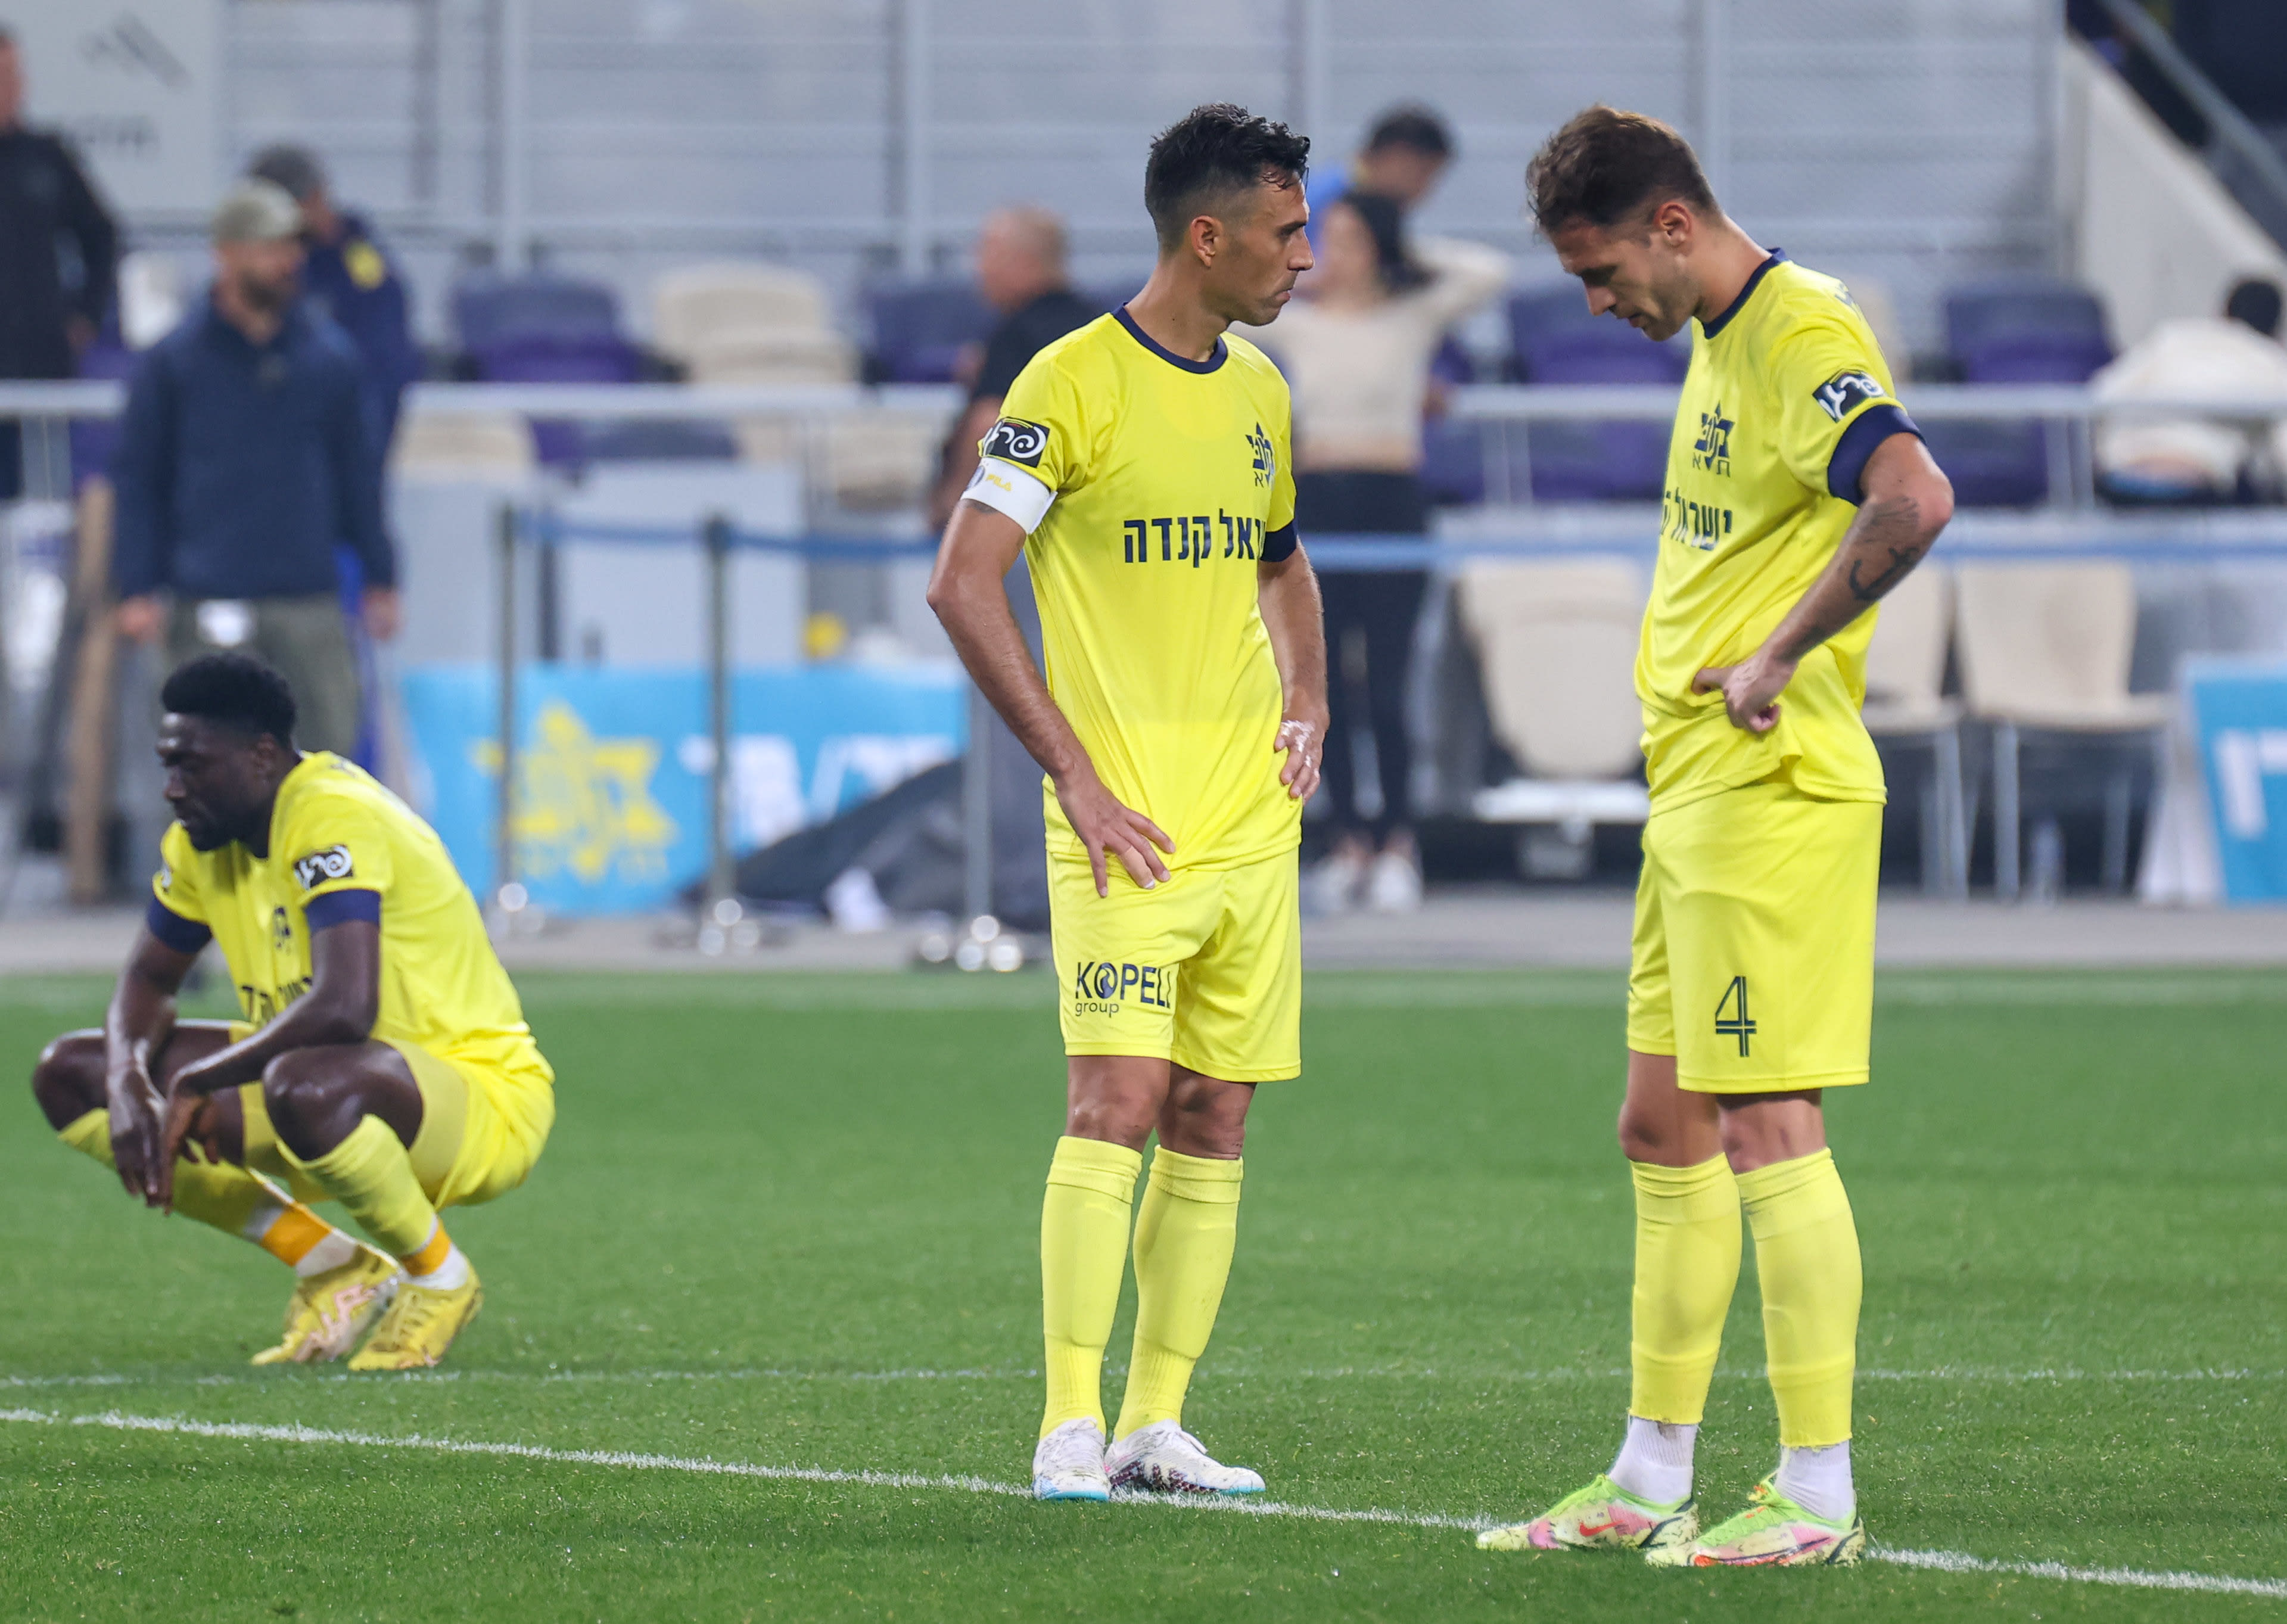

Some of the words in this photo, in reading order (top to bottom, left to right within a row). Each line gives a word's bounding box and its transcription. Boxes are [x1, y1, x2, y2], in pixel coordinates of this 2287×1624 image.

[1124, 516, 1212, 568] קנדה
[1075, 1001, 1120, 1018] group
[1715, 975, 1757, 1057] 4
